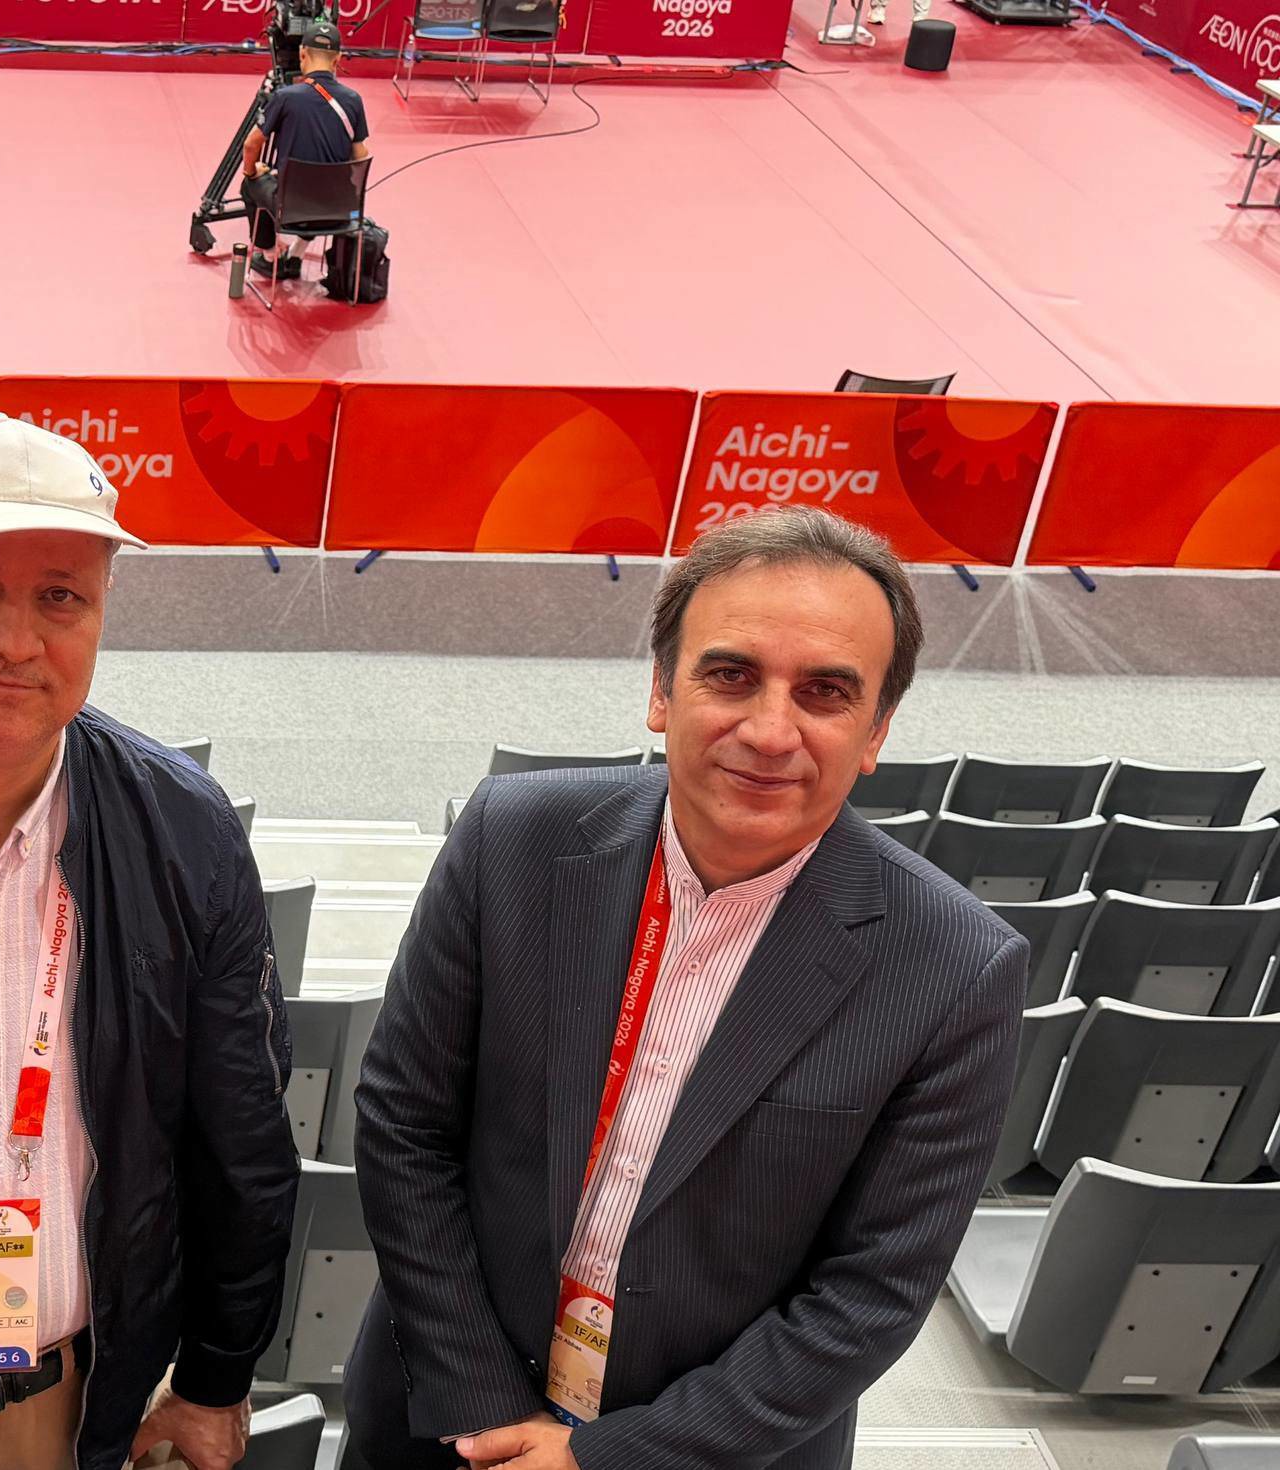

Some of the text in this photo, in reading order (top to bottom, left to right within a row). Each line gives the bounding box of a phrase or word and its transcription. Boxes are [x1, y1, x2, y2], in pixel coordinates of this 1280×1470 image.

[653, 0, 732, 18] Nagoya
[661, 19, 714, 37] 2026
[715, 422, 850, 459] Aichi-
[96, 453, 173, 487] oya
[705, 461, 880, 503] Nagoya
[44, 904, 67, 998] Aichi-Nagoya
[614, 916, 661, 1047] Aichi-Nagoya 2026
[574, 1325, 608, 1348] IF/AF
